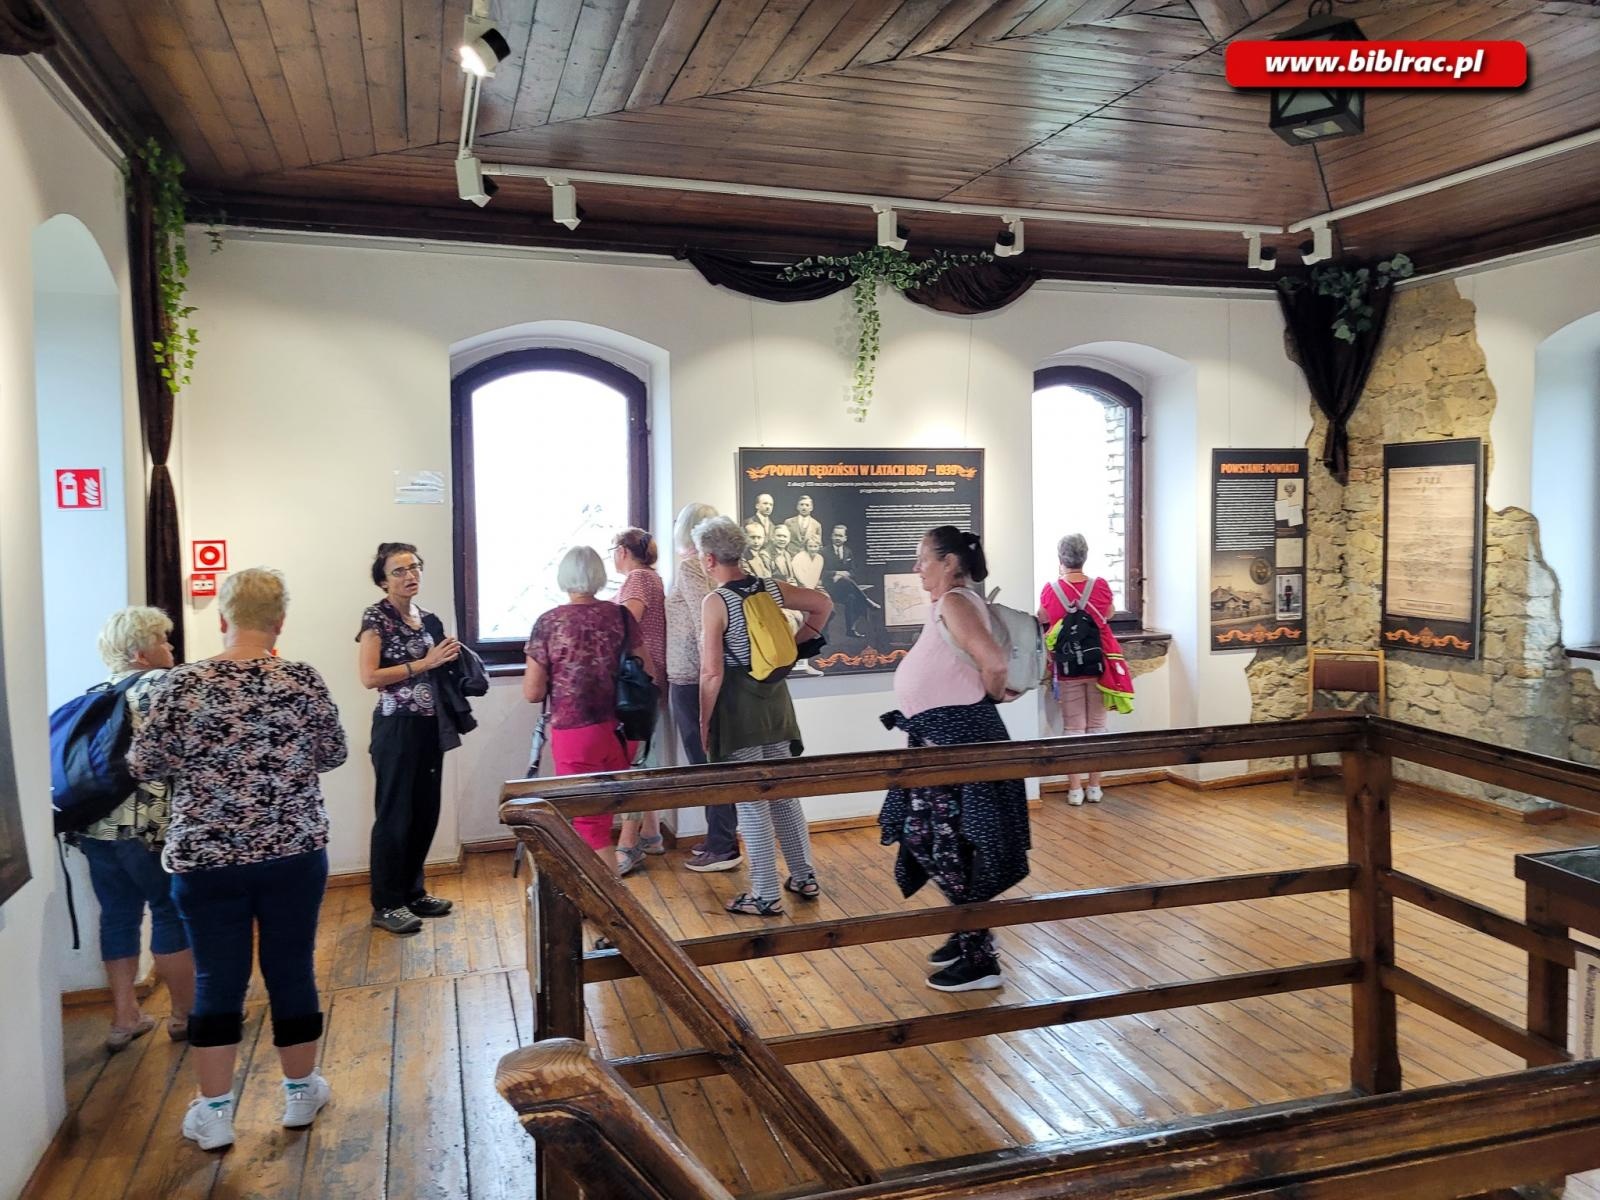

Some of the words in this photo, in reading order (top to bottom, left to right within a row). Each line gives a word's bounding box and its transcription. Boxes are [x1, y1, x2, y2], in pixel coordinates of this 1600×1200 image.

[769, 464, 808, 477] POWIAT
[809, 462, 858, 480] BĘDZIŃSKI
[860, 464, 870, 476] W
[870, 464, 905, 476] LATACH
